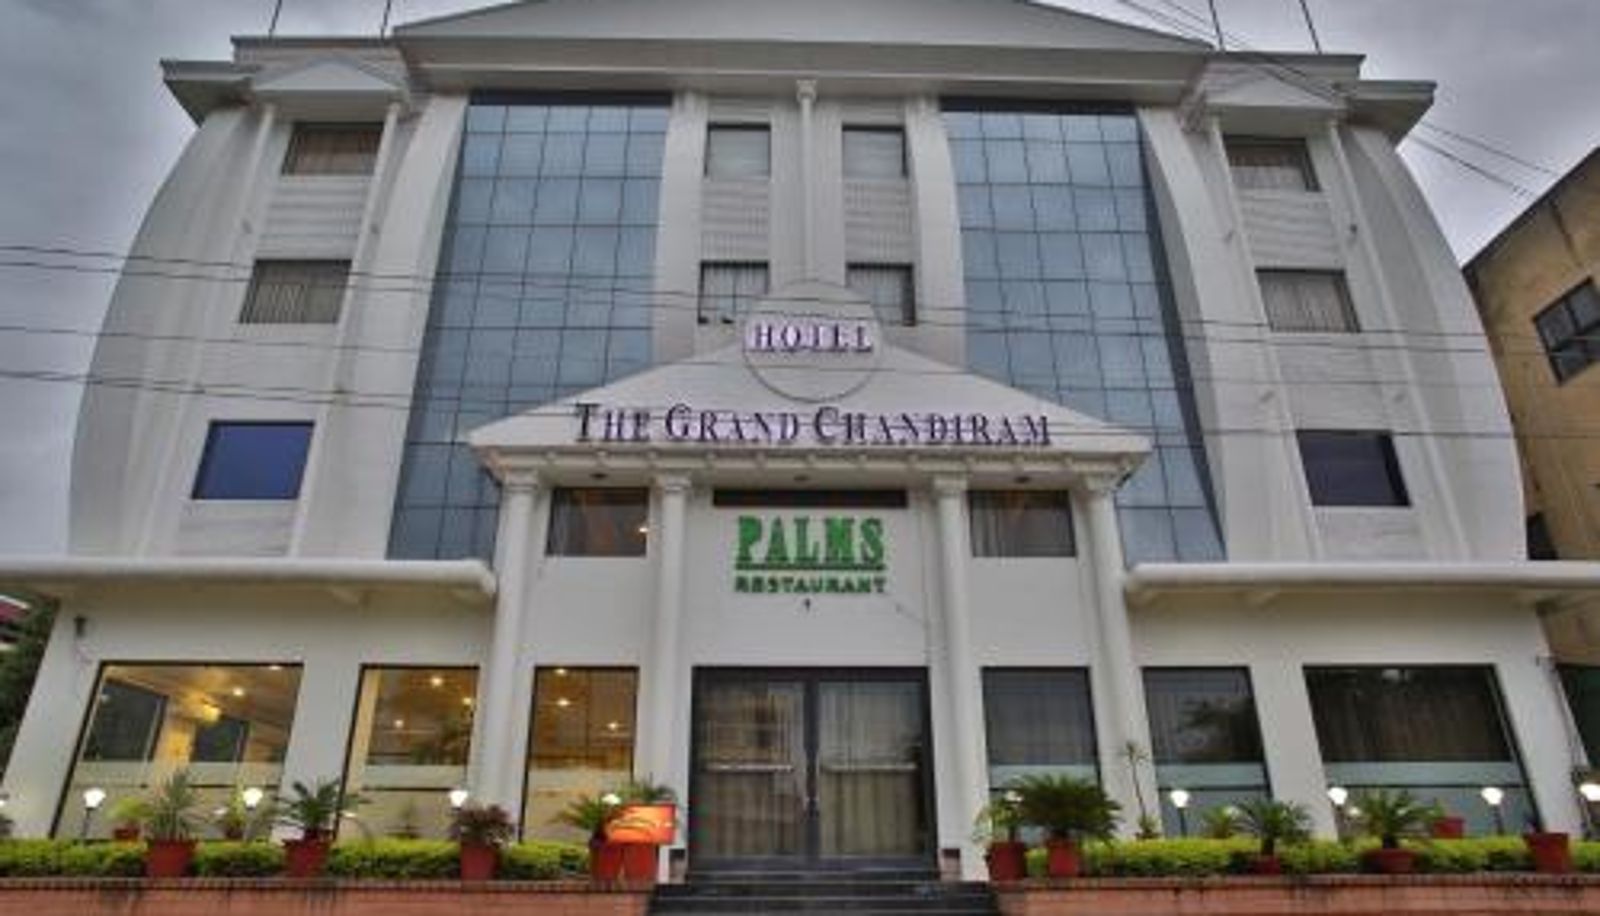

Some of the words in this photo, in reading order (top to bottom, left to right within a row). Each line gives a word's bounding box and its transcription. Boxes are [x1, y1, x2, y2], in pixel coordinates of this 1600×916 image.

[575, 402, 651, 442] THE
[664, 403, 799, 442] GRAND
[813, 405, 1051, 446] CHANDIRAM
[735, 515, 886, 567] PALMS
[734, 576, 886, 593] RESTAURANT
